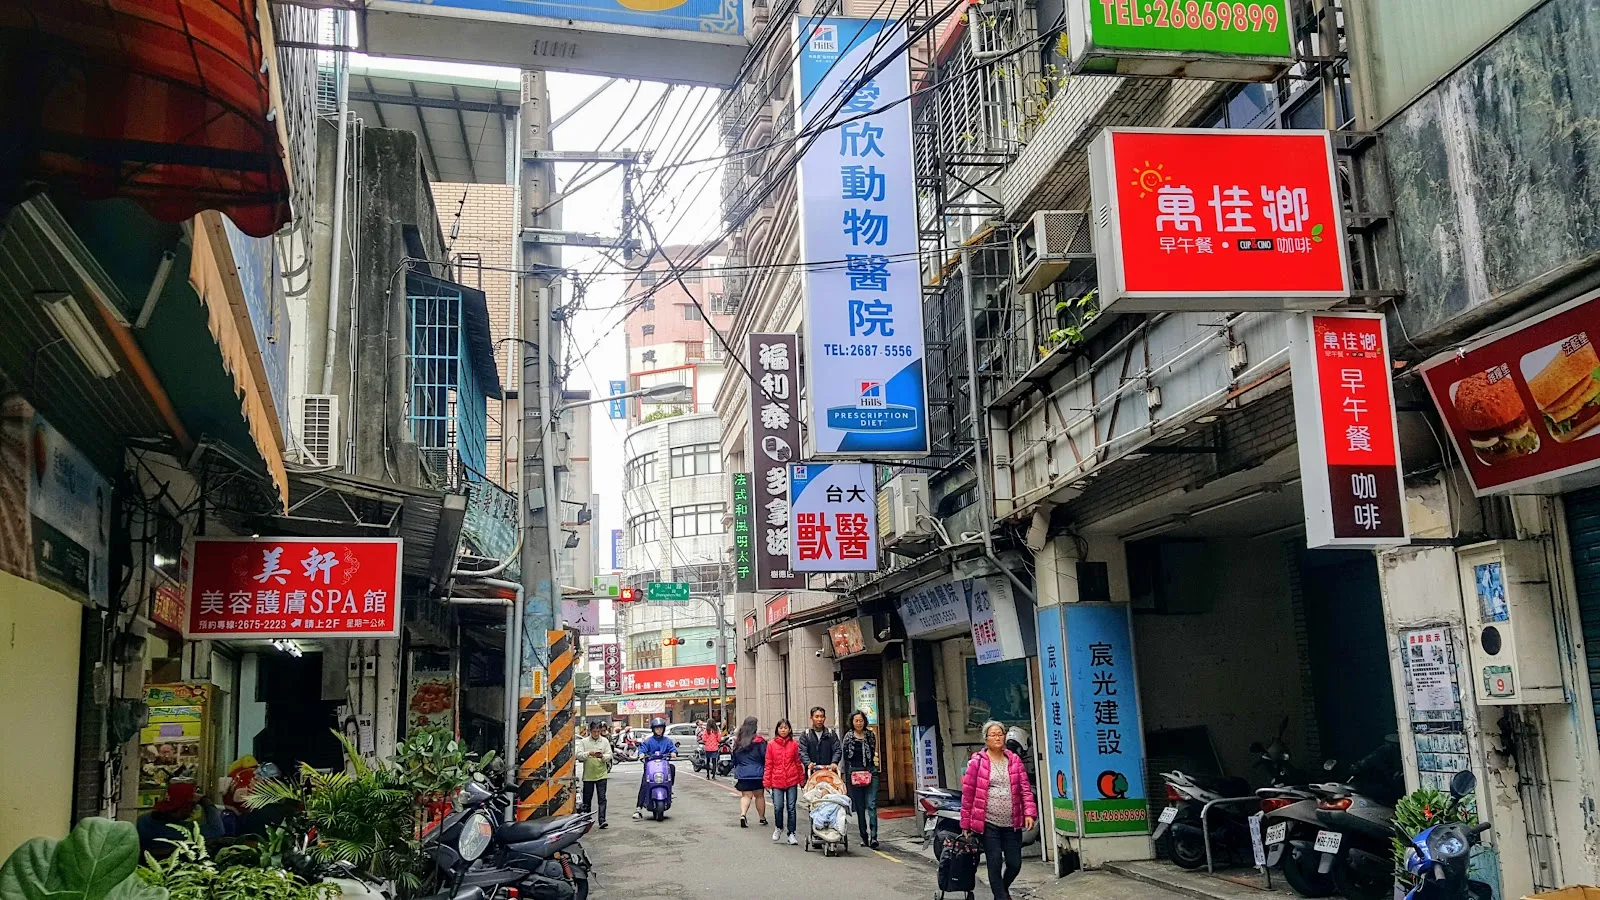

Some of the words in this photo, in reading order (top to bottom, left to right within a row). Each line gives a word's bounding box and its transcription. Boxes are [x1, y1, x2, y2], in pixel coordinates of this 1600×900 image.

[1100, 0, 1279, 32] TEL:26869899
[813, 41, 835, 50] Hill's
[839, 78, 895, 339] 愛欣動物醫院
[1155, 184, 1310, 233] 萬佳鄉
[1159, 236, 1214, 254] 早午餐
[1276, 237, 1313, 254] 咖啡
[823, 343, 913, 357] TEL:2687-5556
[1323, 331, 1377, 350] 萬佳鄉
[860, 398, 882, 407] Hill's
[1340, 368, 1373, 452] 早午餐
[826, 484, 866, 503] 台大
[1351, 472, 1381, 530] 咖啡
[734, 473, 750, 579] 法式和風明太子
[796, 511, 870, 561] 獸醫
[252, 546, 340, 585] 美軒
[304, 618, 341, 629] 請上2F
[1046, 643, 1064, 755] 宸光建設
[1088, 641, 1123, 756] 宸光建設
[1496, 678, 1505, 692] 9
[1084, 807, 1147, 822] TEL:26869899
